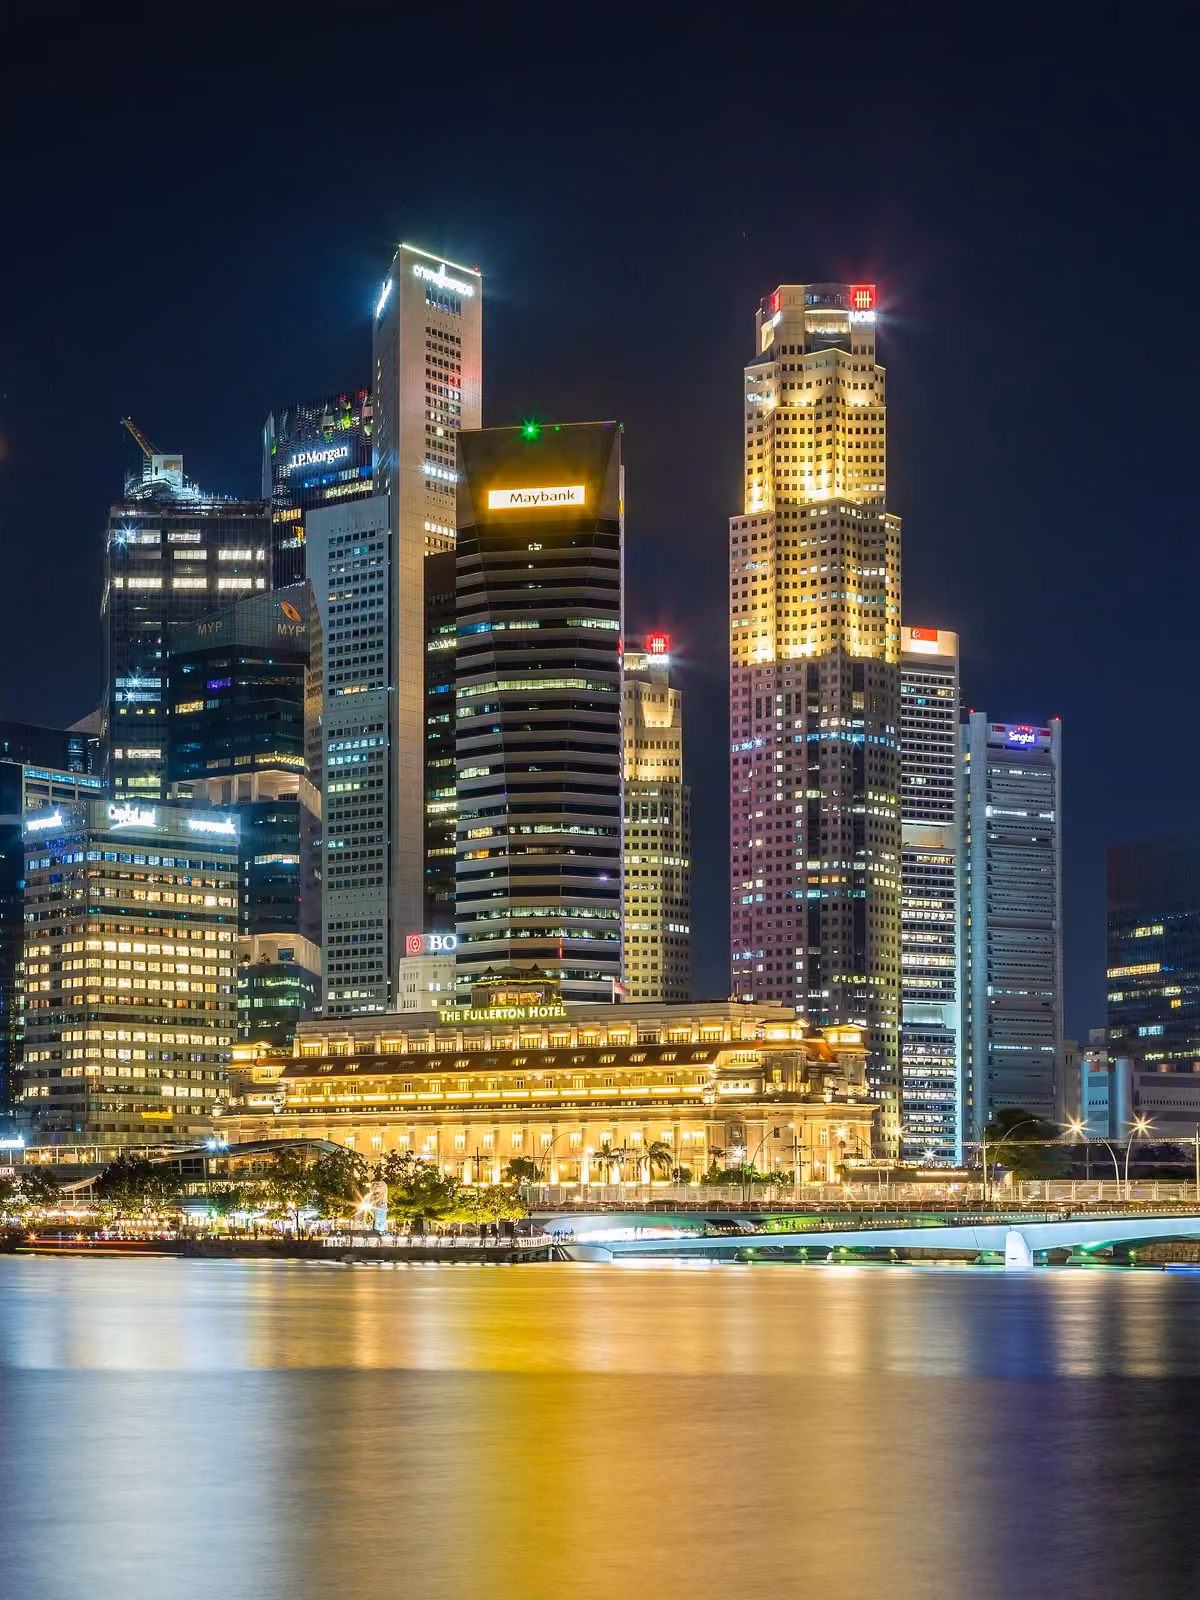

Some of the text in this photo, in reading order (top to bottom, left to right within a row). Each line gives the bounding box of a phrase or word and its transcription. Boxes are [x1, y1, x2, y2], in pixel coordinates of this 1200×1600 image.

[289, 446, 348, 469] J.P.Morgan
[509, 489, 575, 505] Maybank
[197, 621, 223, 636] MYP
[277, 623, 303, 637] MYP
[1008, 731, 1035, 745] Singtel
[439, 1006, 567, 1021] THE FULLERTON HOTEL
